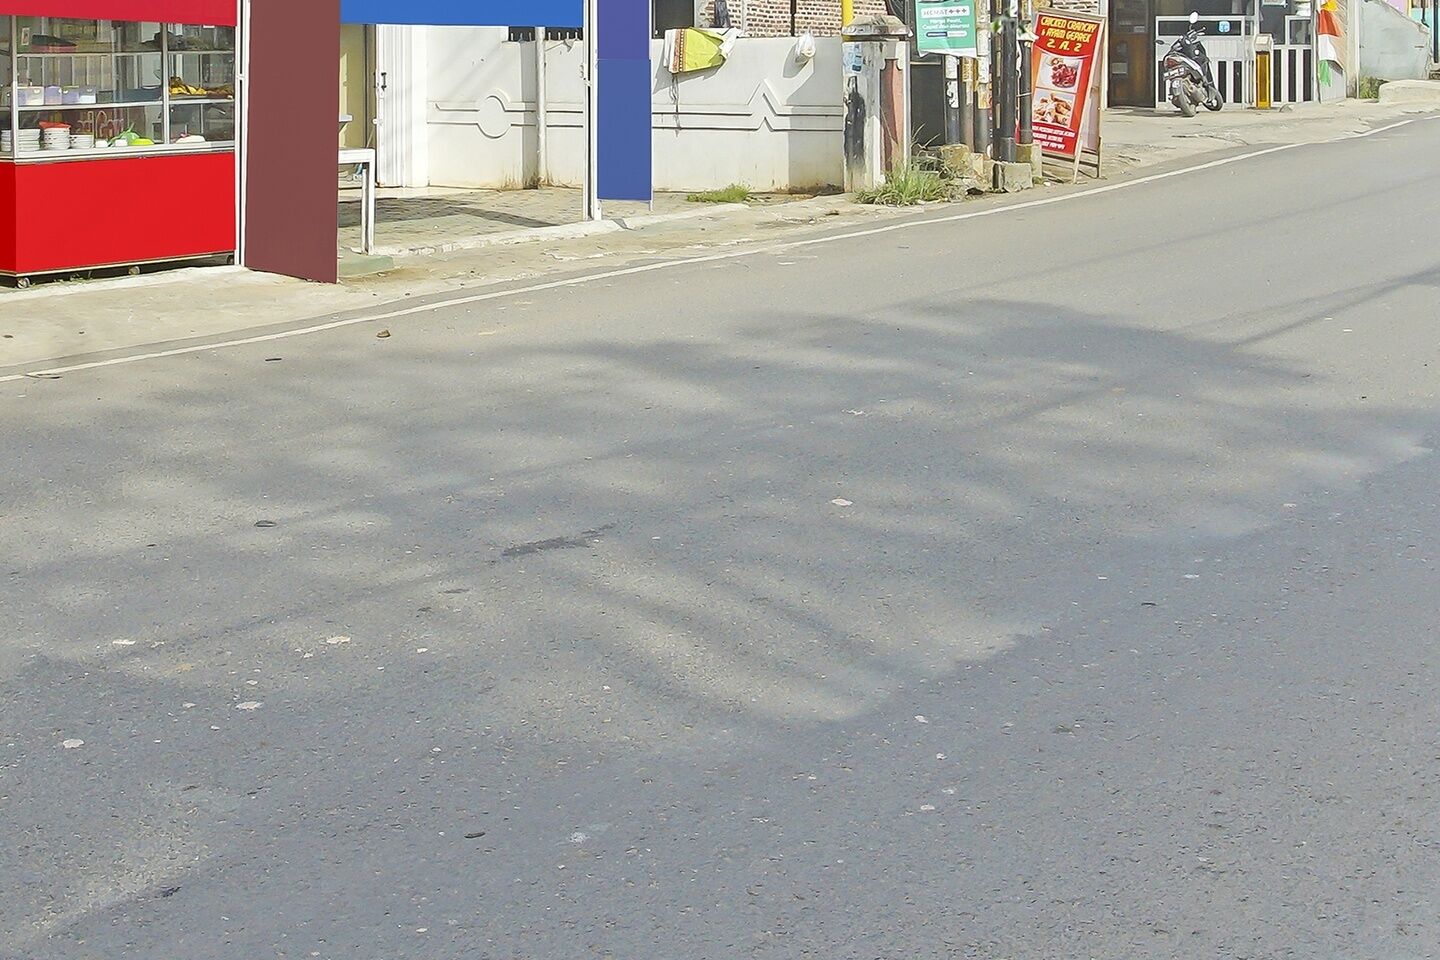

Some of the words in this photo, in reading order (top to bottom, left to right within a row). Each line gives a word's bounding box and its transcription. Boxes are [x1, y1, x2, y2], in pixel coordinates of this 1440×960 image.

[1040, 16, 1067, 28] CHICKEN
[1046, 27, 1066, 38] AYAM
[1066, 30, 1092, 43] GEPREK
